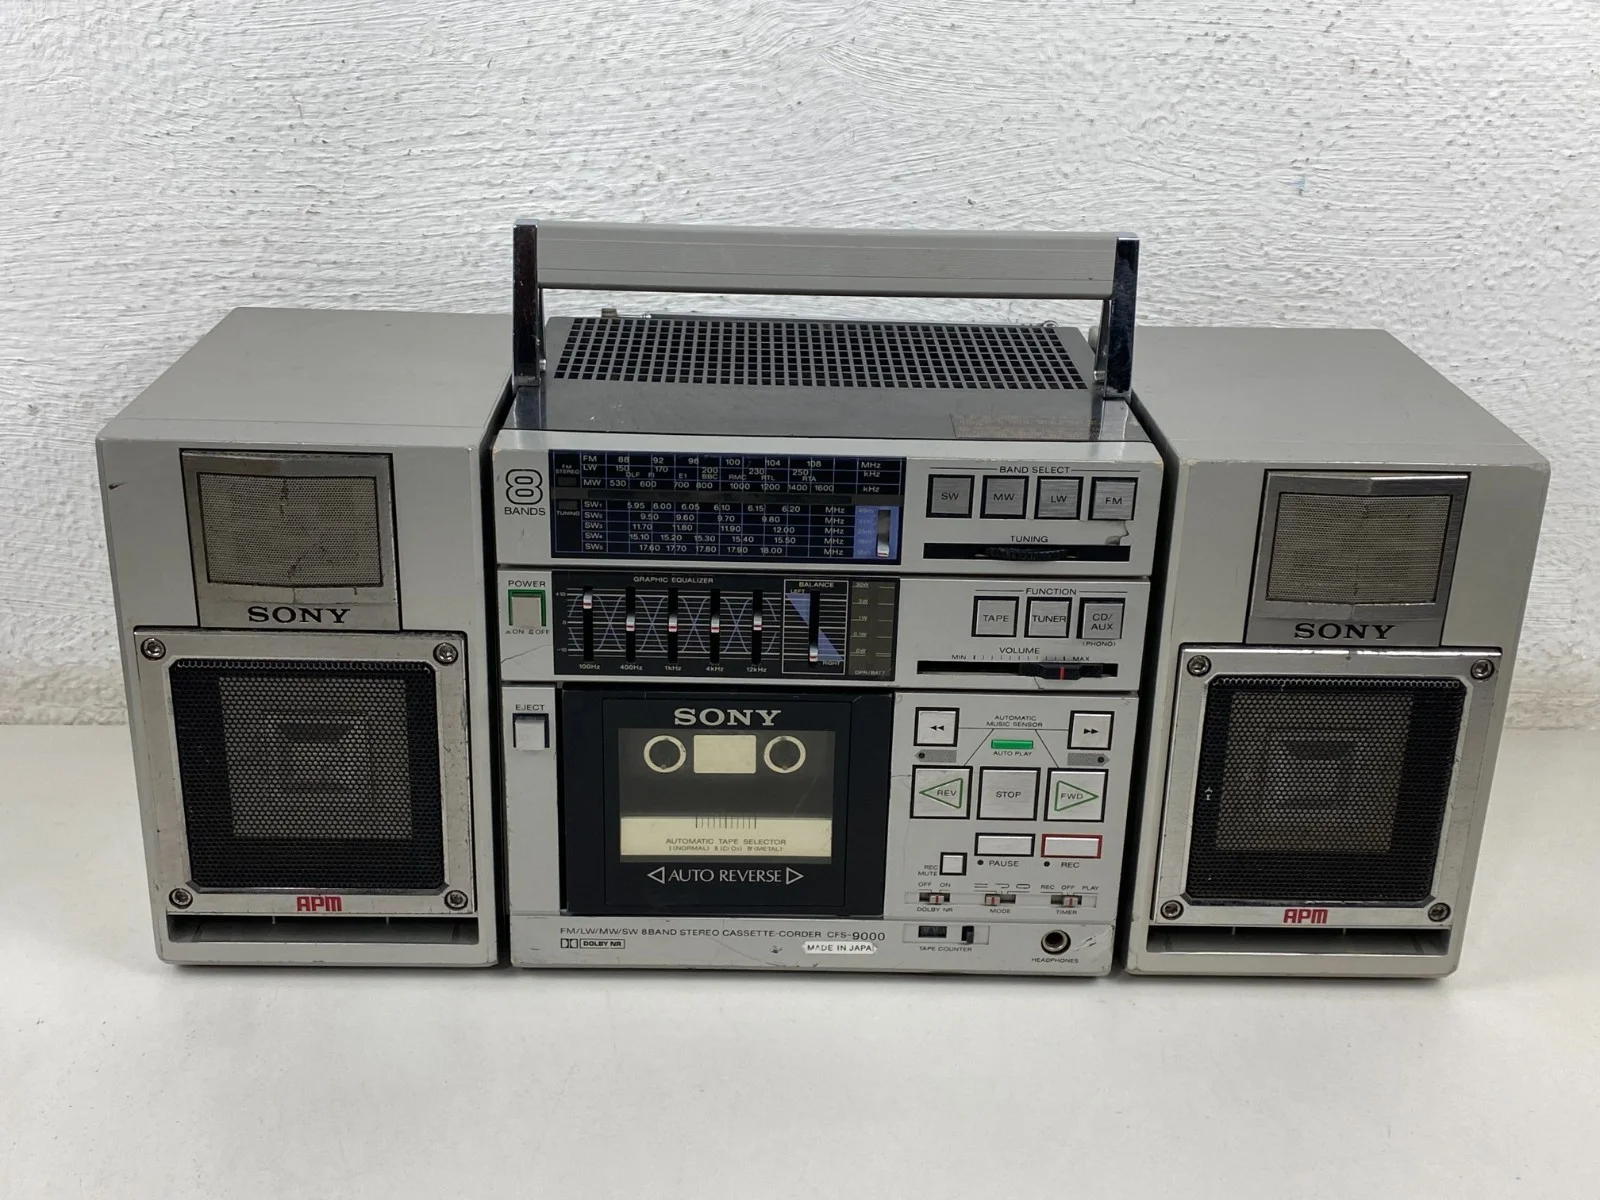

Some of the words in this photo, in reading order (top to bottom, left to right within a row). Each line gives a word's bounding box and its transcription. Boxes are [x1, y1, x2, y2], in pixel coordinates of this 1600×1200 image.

[1000, 466, 1029, 474] BAND
[1032, 466, 1070, 474] SELECT
[505, 468, 543, 505] 8
[941, 492, 959, 500] SW
[993, 493, 1015, 501] MW
[1050, 495, 1067, 503] LW
[1105, 497, 1123, 505] FM
[681, 503, 700, 511] 6.05
[504, 507, 546, 516] BANDS
[247, 606, 350, 623] SONY
[1092, 613, 1113, 621] CD/
[1032, 615, 1067, 623] TUNER
[1091, 623, 1113, 631] AUX
[1294, 623, 1396, 639] SONY
[674, 708, 781, 726] SONY
[937, 789, 957, 797] REV
[668, 869, 715, 882] AUTO
[720, 869, 782, 882] REVERSE
[297, 896, 342, 912] APM
[1283, 909, 1328, 924] APM
[722, 930, 821, 938] CASSETTE-CORDER
[827, 931, 886, 941] CFS-9000
